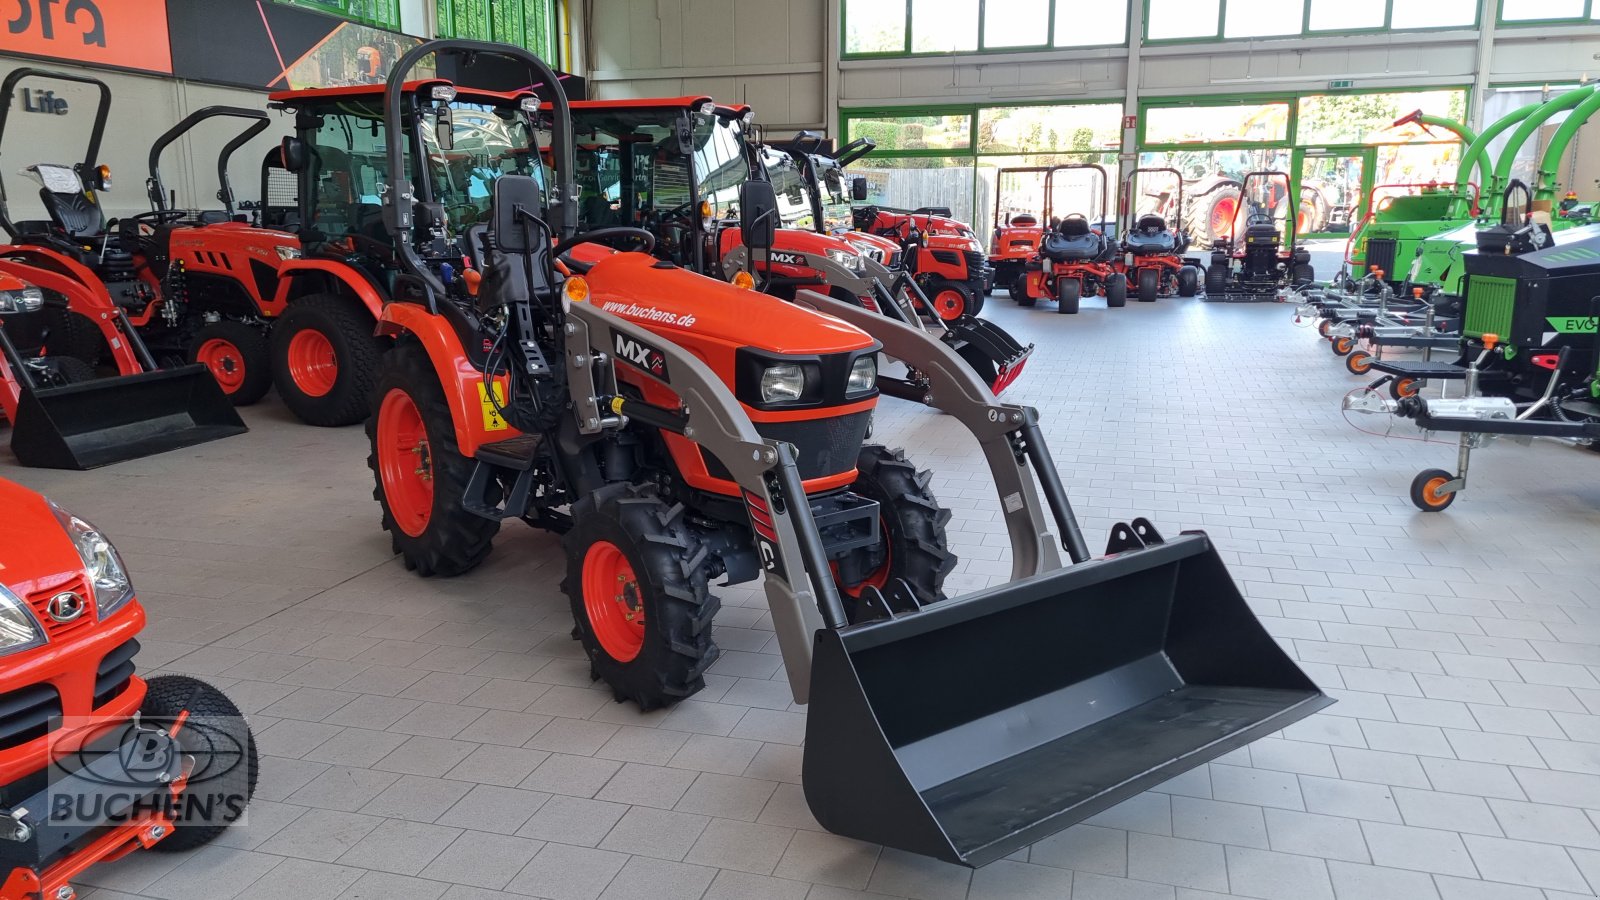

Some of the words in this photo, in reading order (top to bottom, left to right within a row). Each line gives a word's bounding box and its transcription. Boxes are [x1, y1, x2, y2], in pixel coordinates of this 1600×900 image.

[24, 87, 68, 115] Life
[770, 252, 795, 264] MX
[602, 301, 696, 327] www.buchens.de
[616, 333, 651, 369] MX
